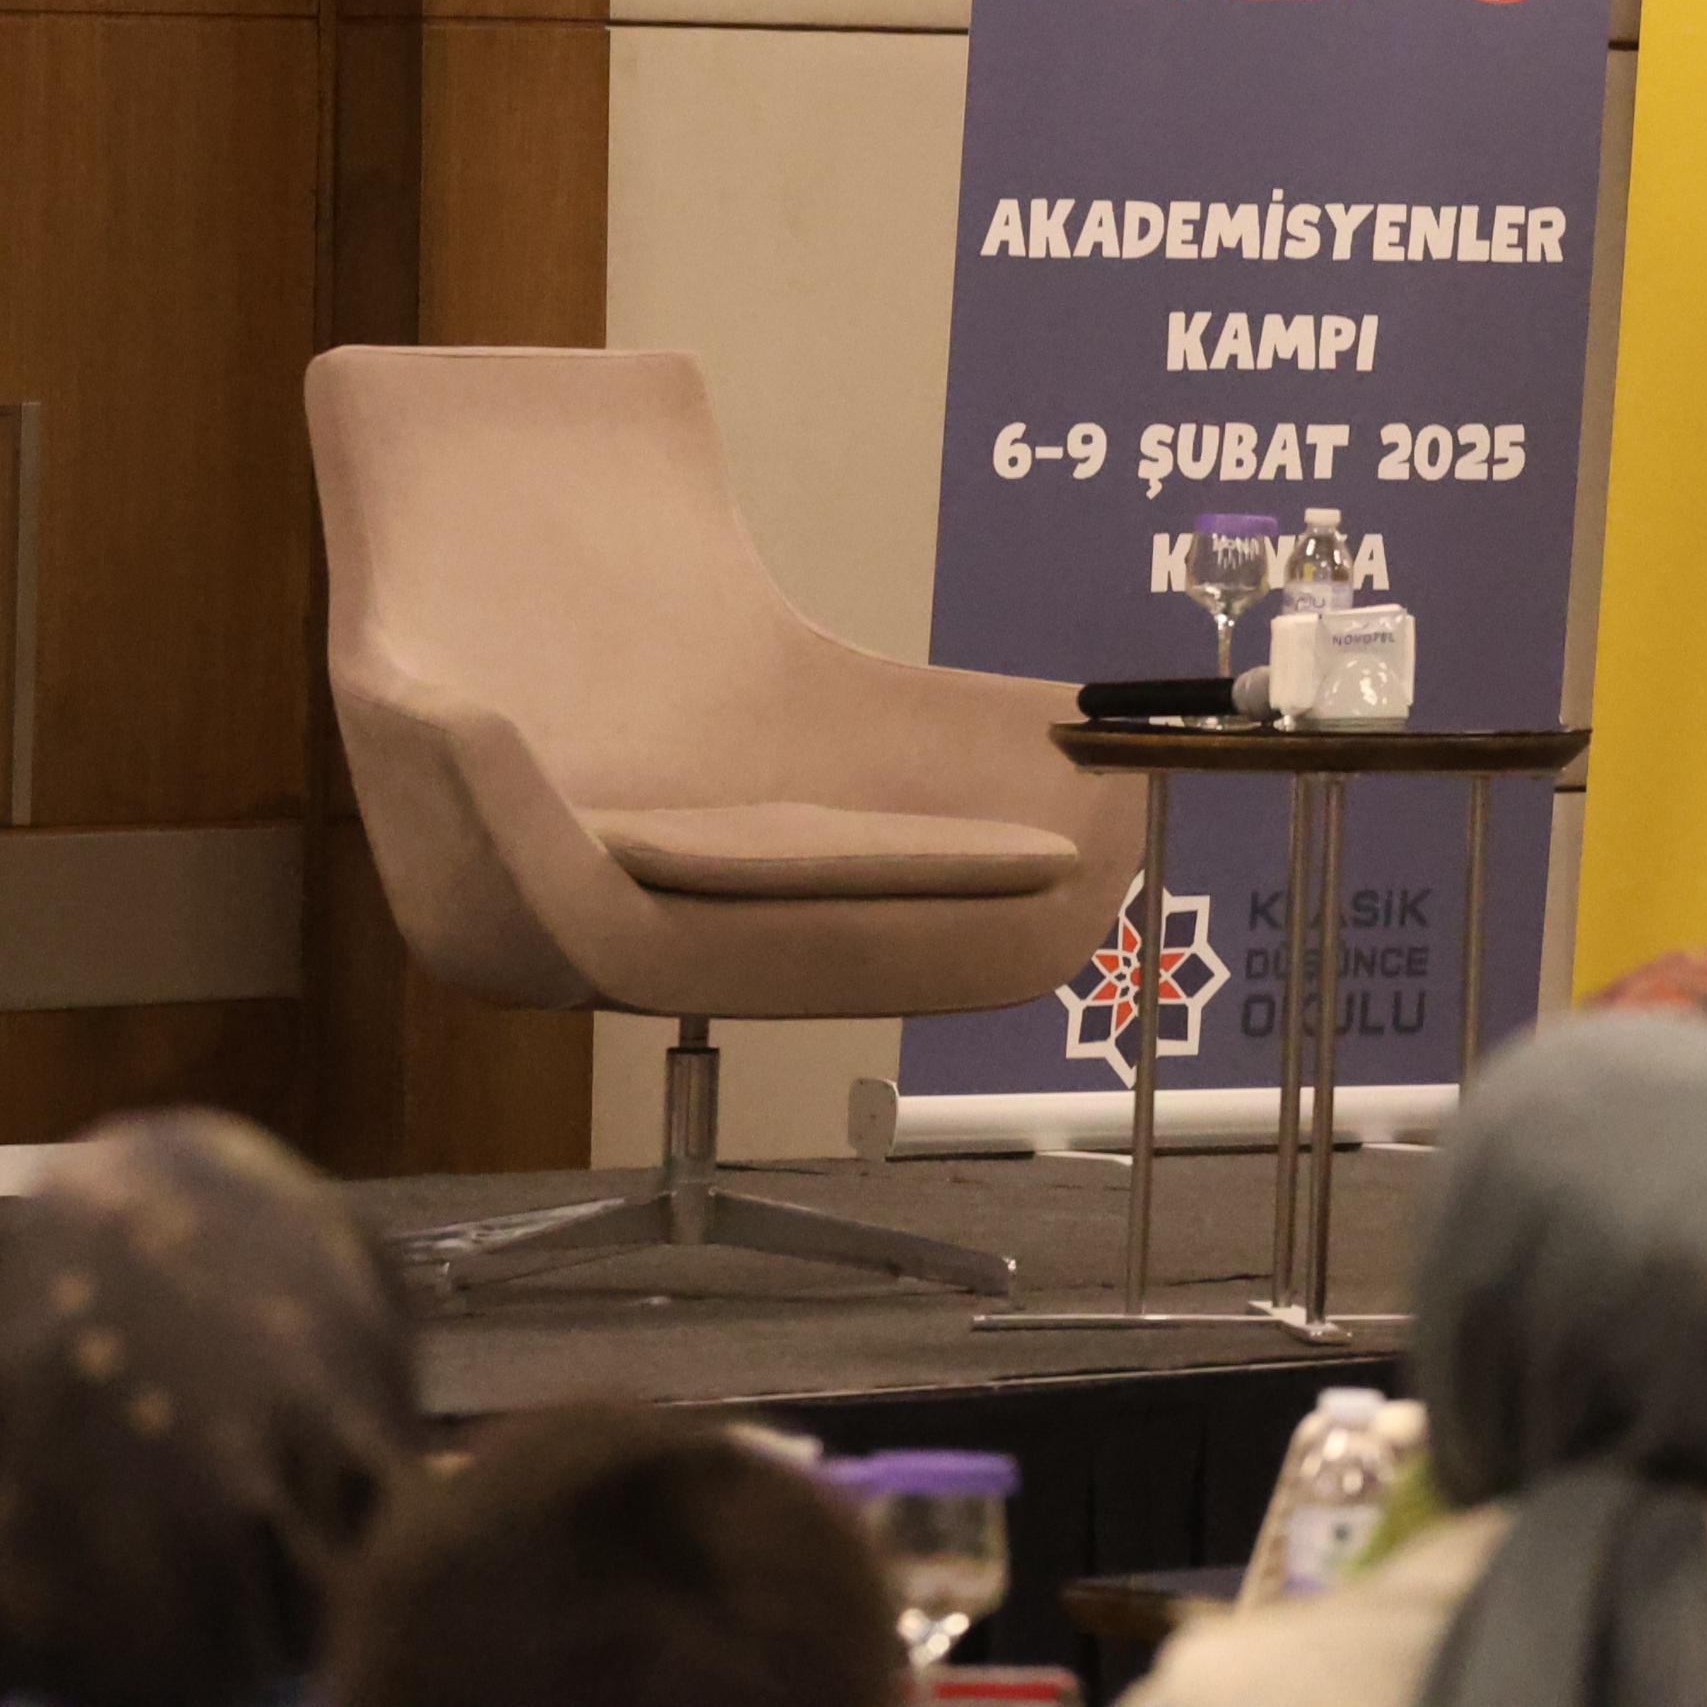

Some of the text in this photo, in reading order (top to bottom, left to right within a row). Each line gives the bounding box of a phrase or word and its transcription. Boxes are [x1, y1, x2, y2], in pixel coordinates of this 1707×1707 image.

[980, 188, 1567, 263] AKADEMİSYENLER
[1167, 311, 1379, 371] KAMPI
[993, 422, 1526, 500] 6-9 ŞUBAT 2025
